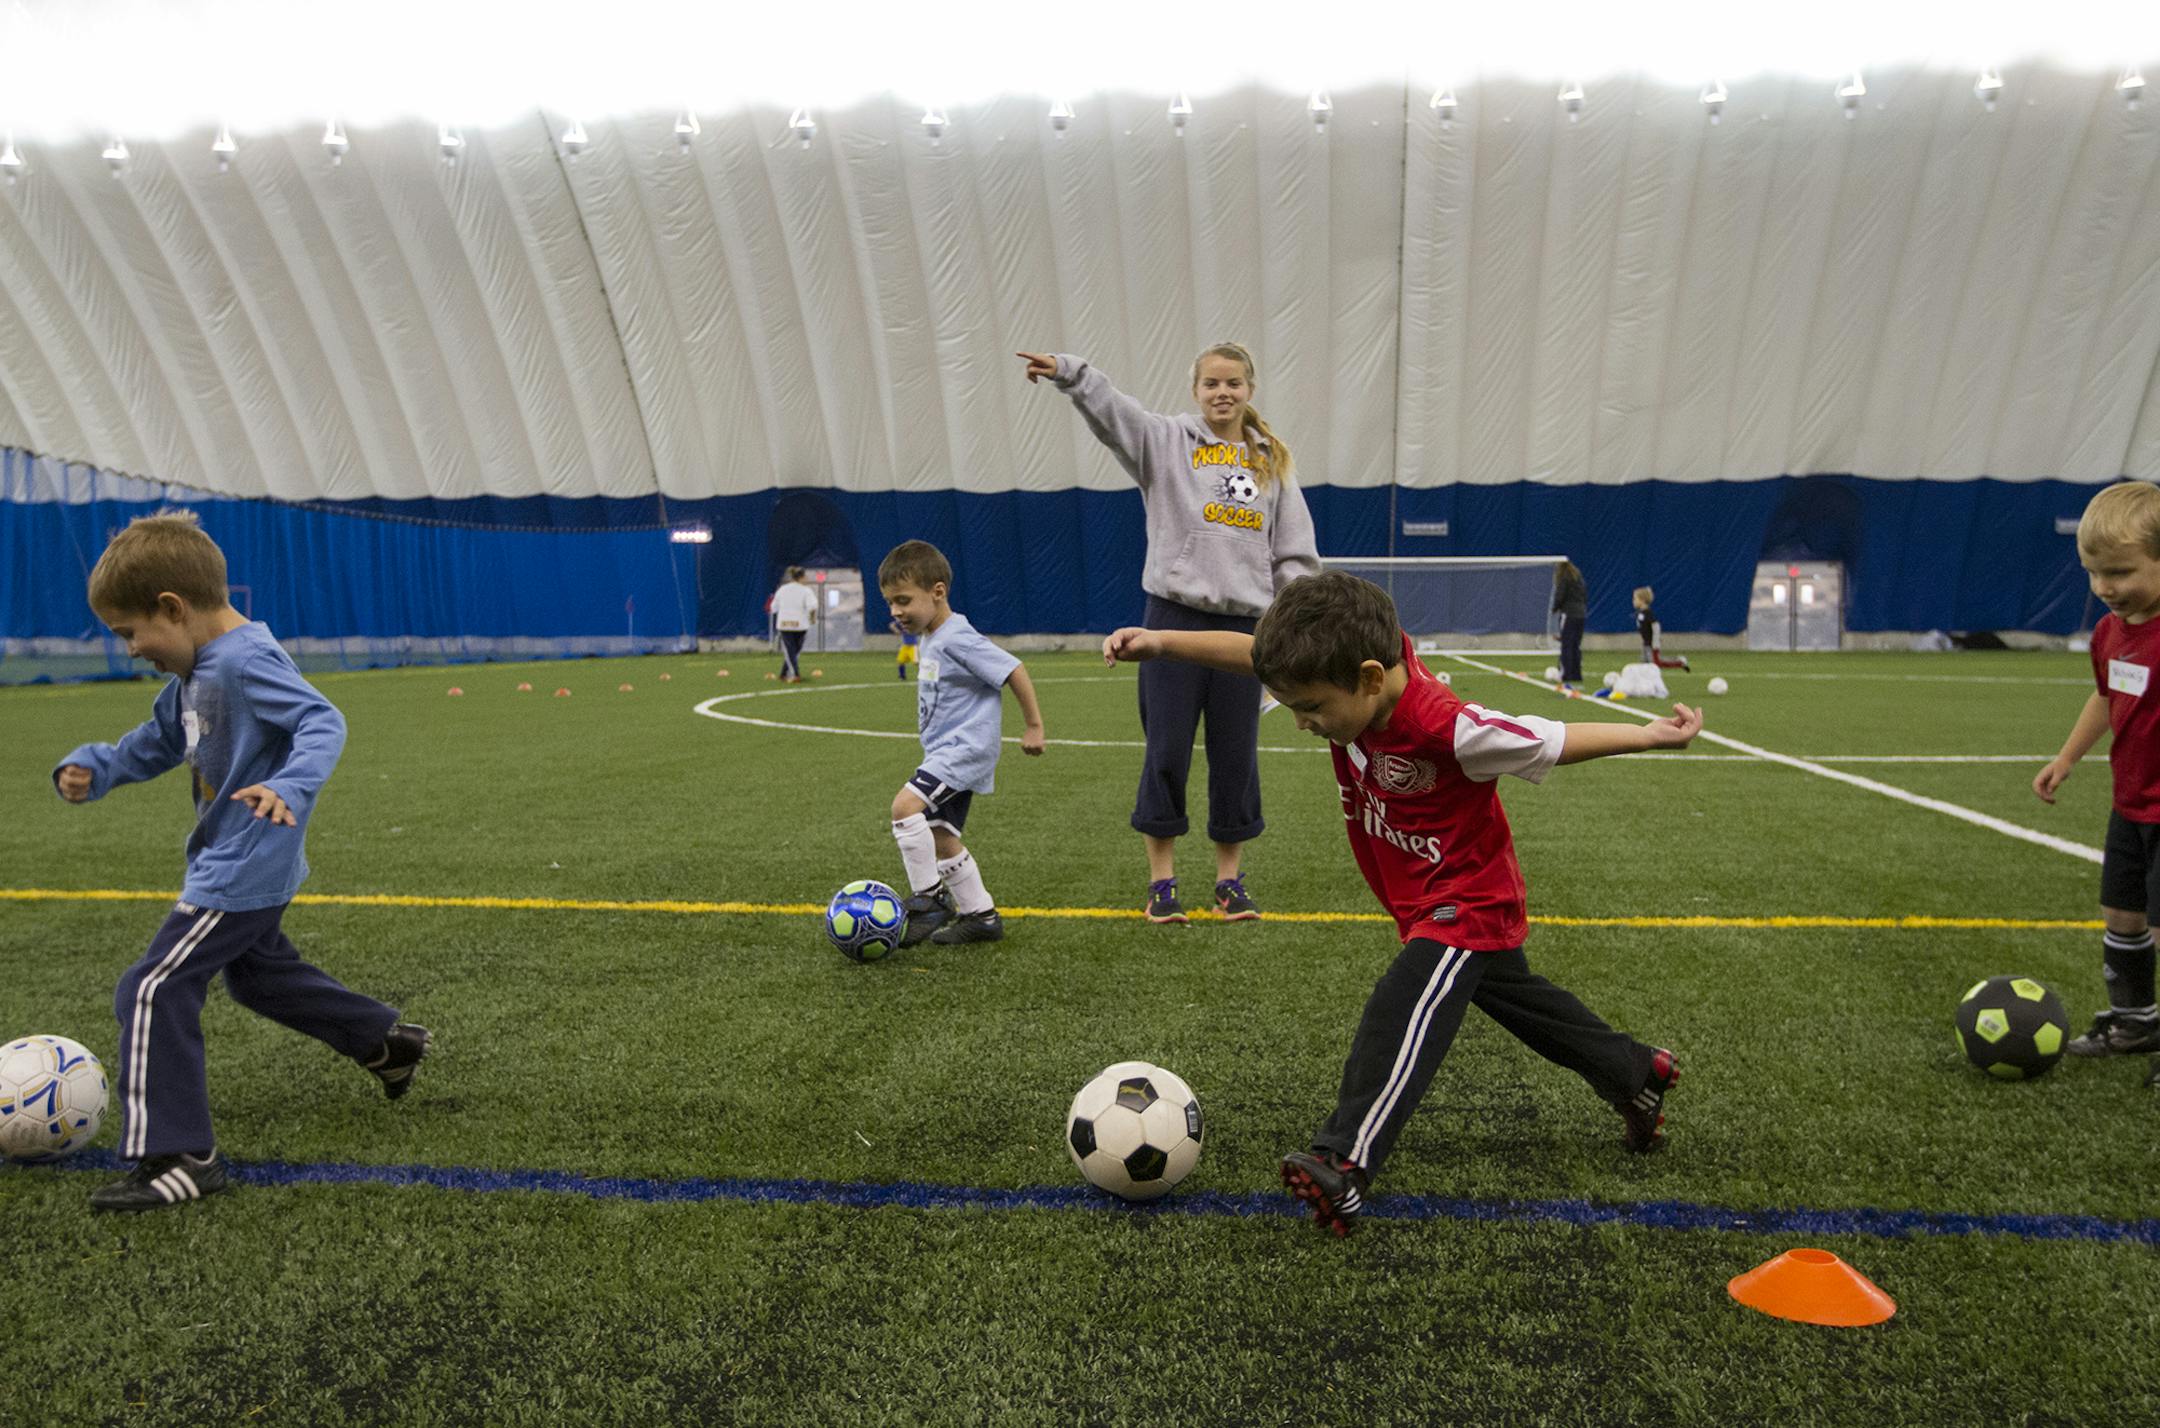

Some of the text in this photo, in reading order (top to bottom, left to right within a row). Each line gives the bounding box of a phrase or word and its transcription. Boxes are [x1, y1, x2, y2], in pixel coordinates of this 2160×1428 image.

[1192, 443, 1238, 469] PRIOR
[1203, 501, 1264, 531] SOCCER
[1338, 784, 1442, 864] Eirates
